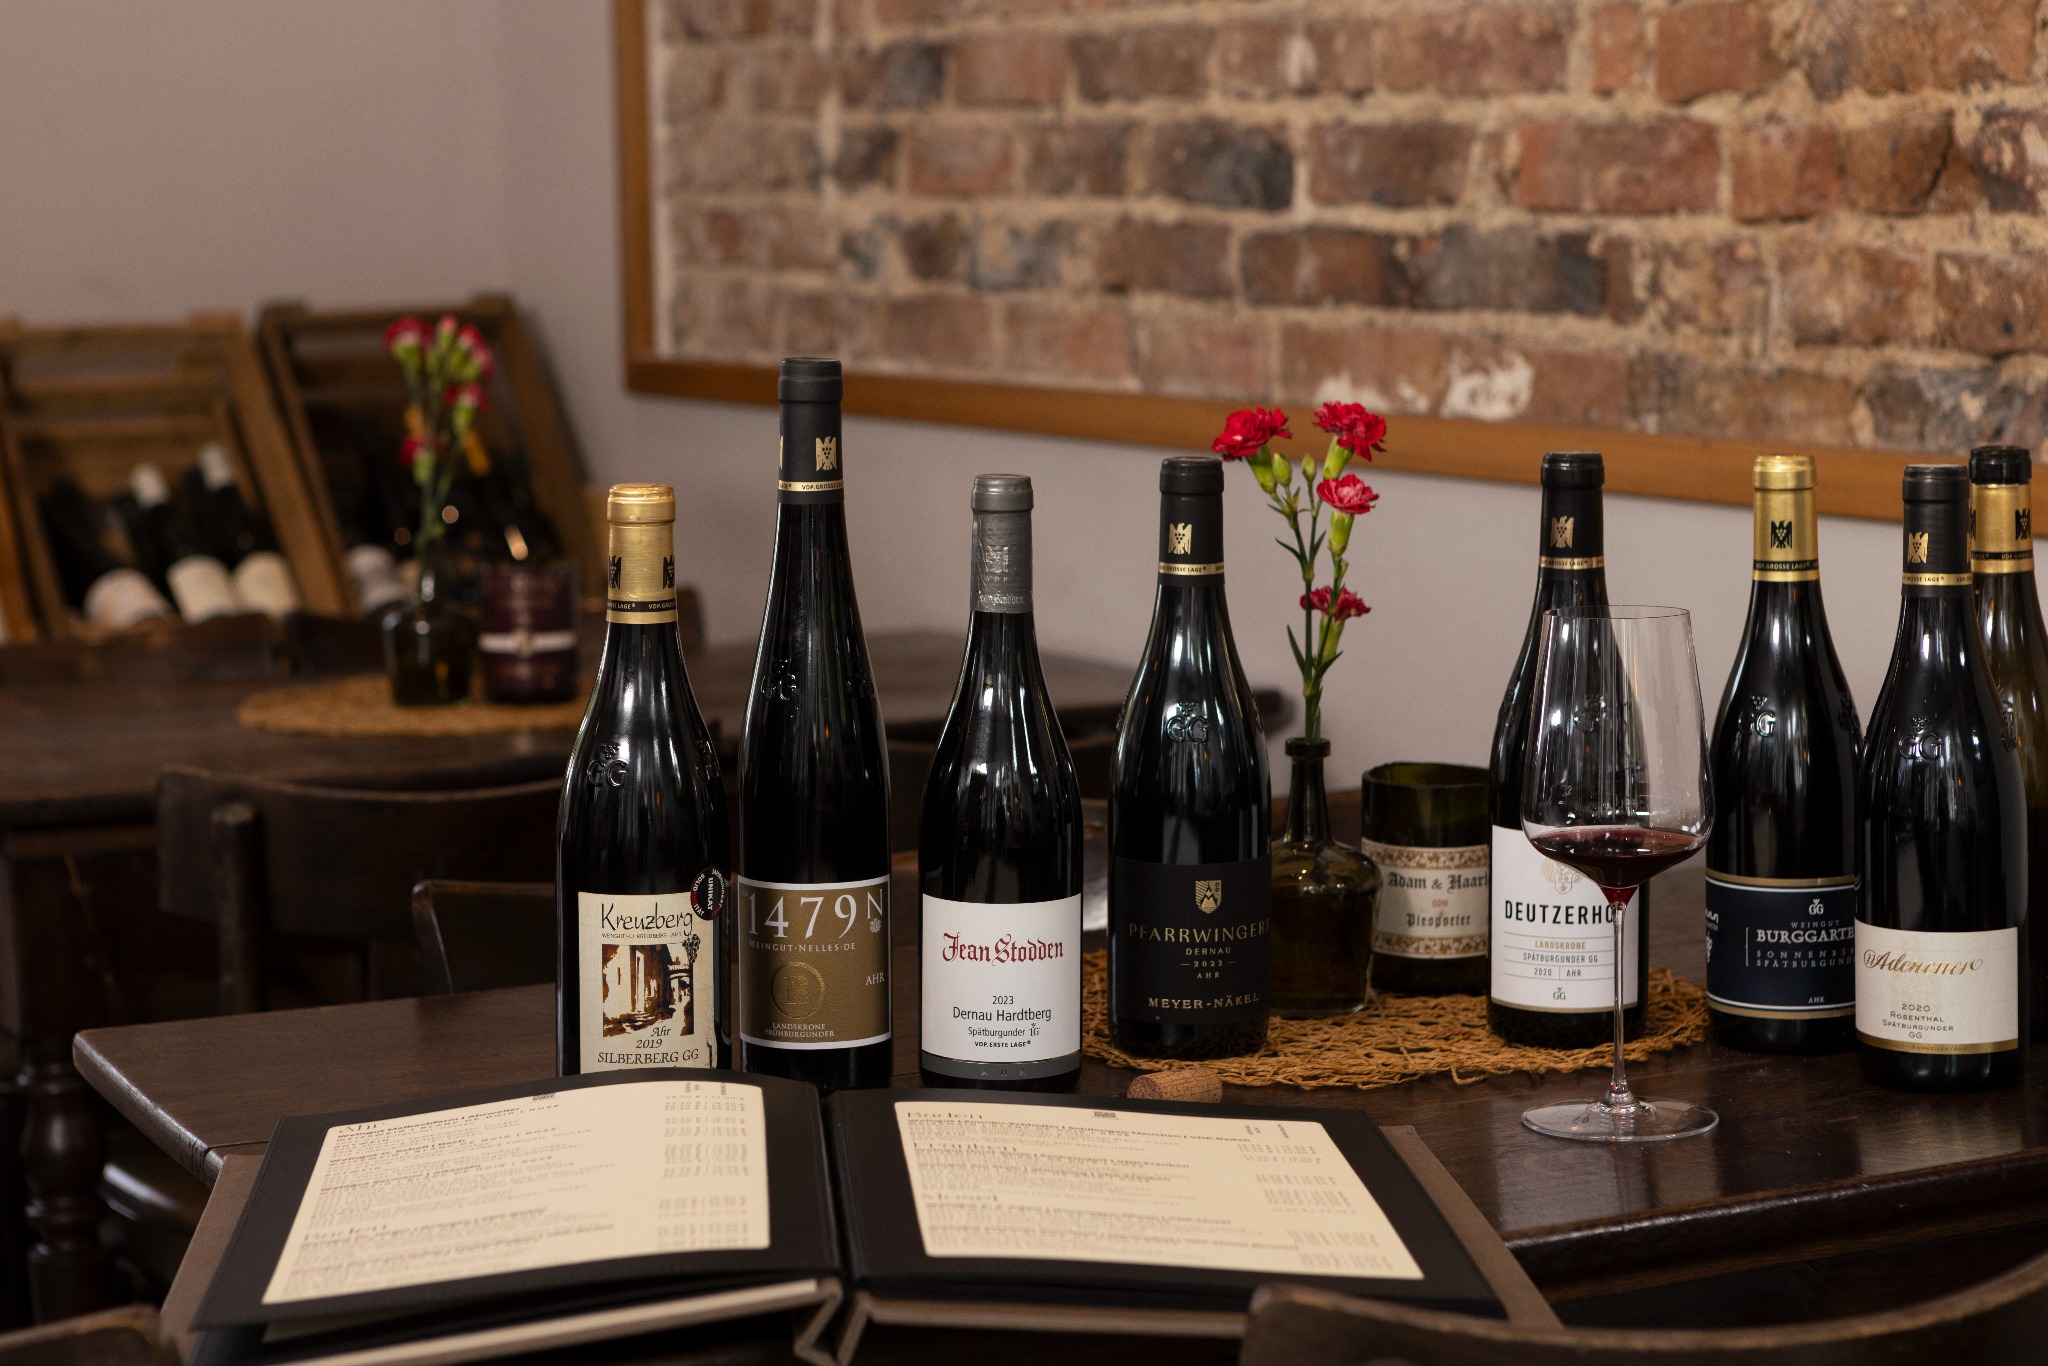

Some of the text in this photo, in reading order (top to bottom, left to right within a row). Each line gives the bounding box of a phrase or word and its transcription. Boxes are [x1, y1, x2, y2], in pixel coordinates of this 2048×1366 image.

[1388, 871, 1427, 889] Adam
[1431, 878, 1442, 890] &
[1505, 899, 1613, 926] DEUTZERHO
[1808, 903, 1824, 915] GG
[601, 901, 693, 937] Kreuzberg
[748, 893, 857, 939] 1479
[1129, 917, 1269, 943] PFARRWINGERT
[1790, 919, 1840, 929] WEINGUT
[1756, 926, 1855, 944] BURGGARTE
[942, 931, 1064, 967] Jean Stodden
[1185, 946, 1231, 956] DERNAU
[1534, 940, 1586, 950] LANDSKRONE
[1522, 951, 1598, 964] SPÄTBURGUNDER GG
[1196, 971, 1220, 979] AHR
[1534, 967, 1582, 977] 2020 AHR
[865, 972, 885, 986] AHR
[992, 995, 1014, 1005] 2023
[1148, 992, 1259, 1009] MEYER-NÄKEL
[1808, 996, 1825, 1004] AHR
[1901, 1003, 1931, 1012] 2020
[953, 1006, 1052, 1022] Dernau Hardtberg
[650, 1025, 672, 1037] Ahr
[765, 1027, 835, 1038] FRÜHBURGUNDER
[772, 1022, 826, 1031] LANDSKRONE
[967, 1026, 1026, 1039] Spätburgunder
[1908, 1031, 1923, 1039] GG
[636, 1038, 663, 1049] 2019
[597, 1048, 699, 1065] SILBERBERG GG
